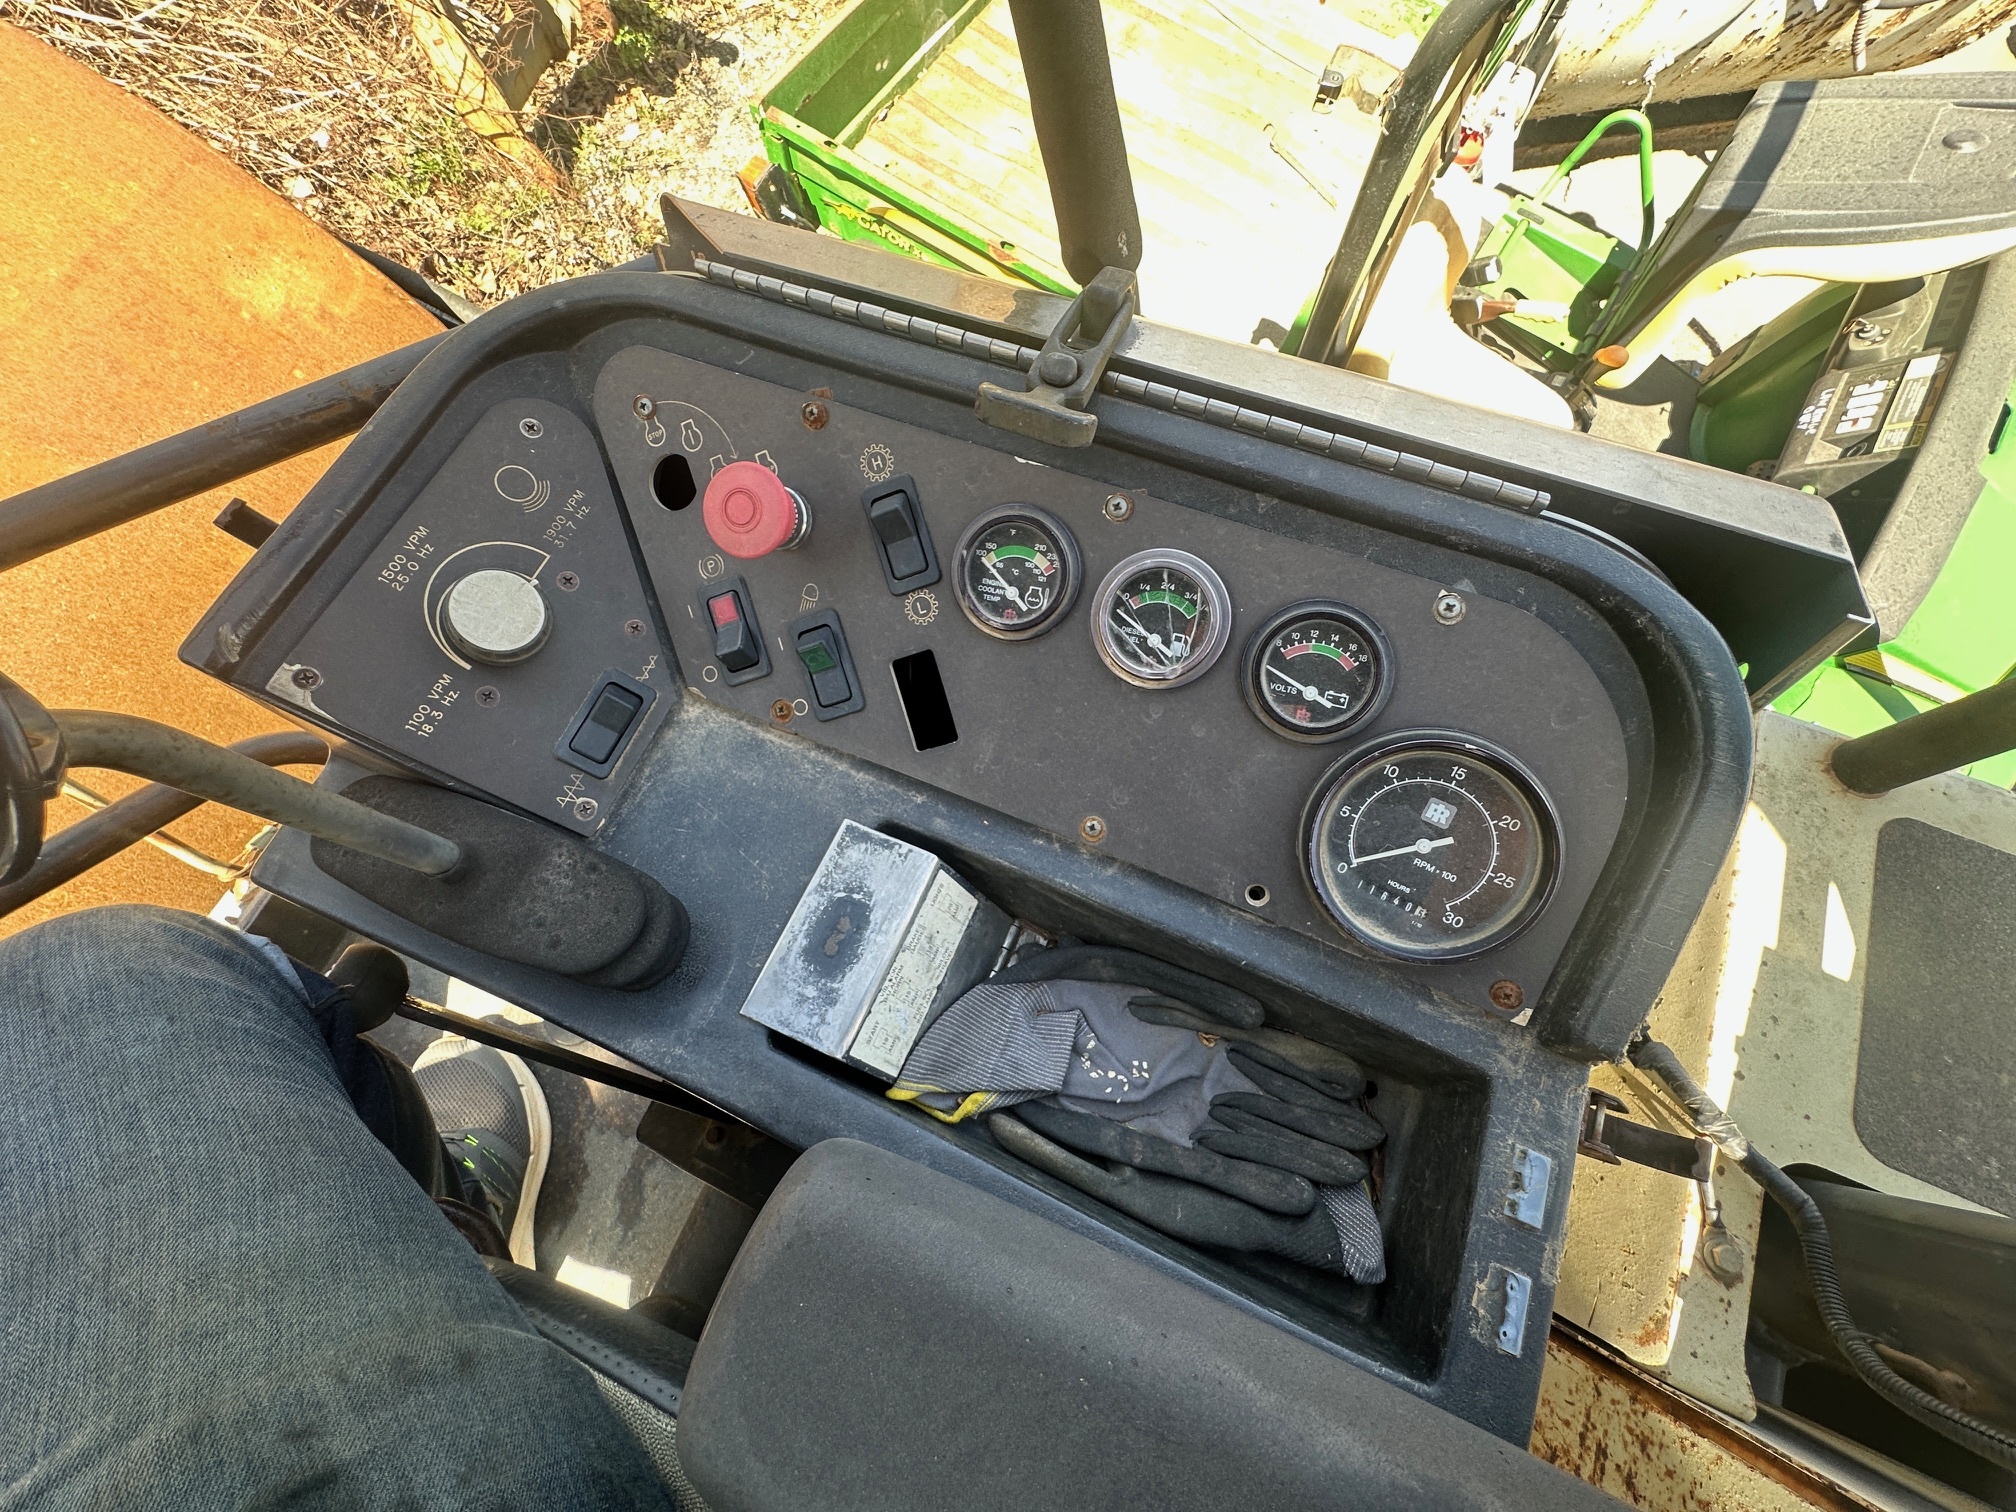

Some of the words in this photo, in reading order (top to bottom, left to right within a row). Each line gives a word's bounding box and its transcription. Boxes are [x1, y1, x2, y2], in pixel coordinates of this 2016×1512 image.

[858, 213, 911, 251] GATOR
[648, 429, 663, 441] STOP
[871, 455, 883, 471] H
[542, 515, 567, 542] 1900
[563, 489, 586, 513] VPM
[554, 521, 575, 548] 31.7
[975, 549, 988, 557] 100
[985, 542, 998, 550] 150
[1034, 543, 1047, 552] 210
[378, 553, 407, 584] 1500
[403, 525, 430, 551] VPM
[707, 561, 715, 573] P
[392, 561, 419, 592] 25.0
[982, 577, 1005, 588] ENGIN
[1140, 583, 1151, 591] 1/4
[983, 593, 1001, 602] TEMP
[1184, 592, 1198, 600] 3/4
[917, 601, 927, 615] L
[1291, 632, 1301, 640] 10
[1310, 630, 1320, 638] 12
[1330, 633, 1340, 642] 14
[1348, 643, 1358, 652] 16
[1358, 654, 1368, 662] 18
[1270, 682, 1298, 695] VOLTS
[405, 704, 431, 732] 1100
[427, 673, 454, 700] VPM
[418, 709, 443, 737] 18.3
[1383, 764, 1400, 778] 10
[1450, 765, 1468, 780] 15
[1339, 805, 1352, 818] 5
[1498, 815, 1521, 832] 20
[1337, 862, 1348, 874] 0
[1413, 858, 1436, 873] RPM
[1441, 870, 1457, 883] 100
[1387, 879, 1411, 894] HOURS
[1493, 872, 1516, 889] 25
[1442, 911, 1464, 929] 30
[891, 975, 904, 997] HORN
[865, 1021, 880, 1046] START
